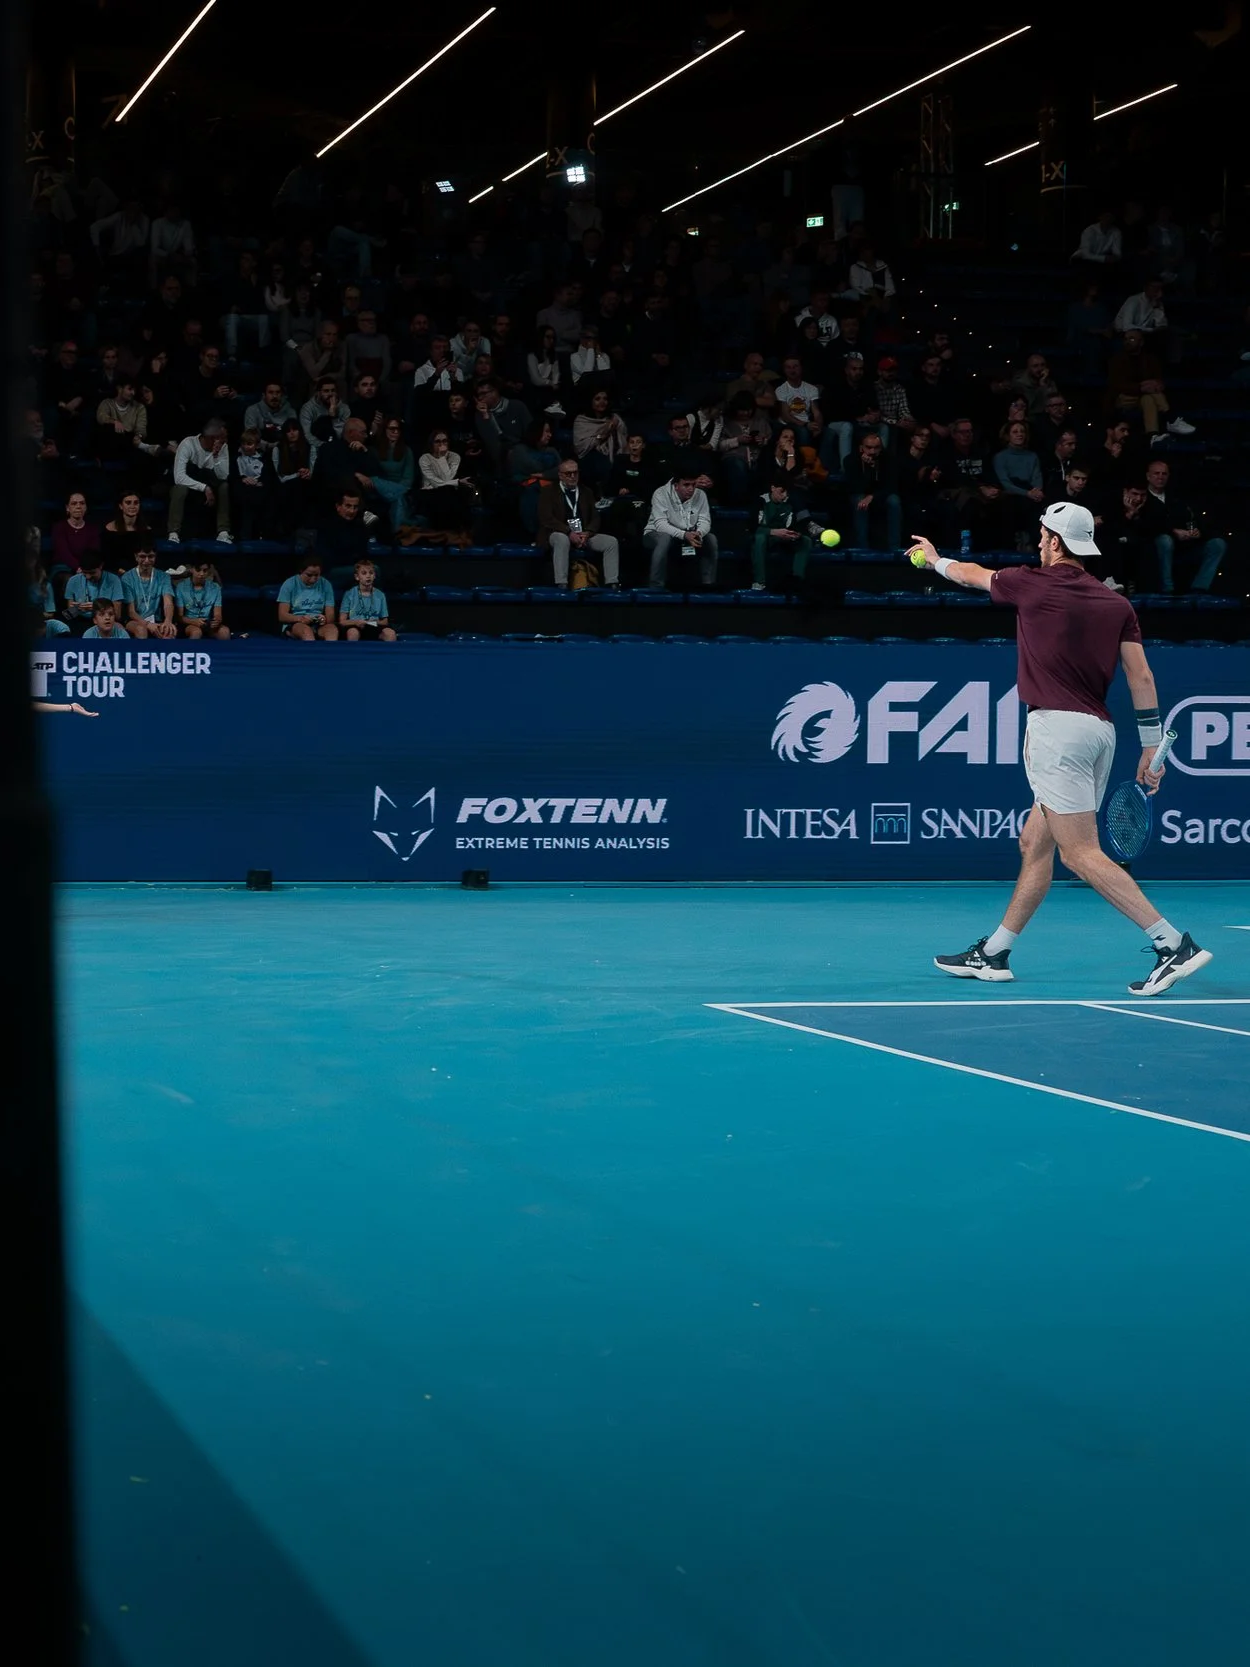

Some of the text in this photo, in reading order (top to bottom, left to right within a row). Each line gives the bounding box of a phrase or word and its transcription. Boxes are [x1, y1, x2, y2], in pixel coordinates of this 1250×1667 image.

[62, 651, 211, 674] CHALLENGER
[62, 675, 125, 698] TOUR
[456, 798, 667, 824] FOXTENN
[744, 808, 860, 839] INTESA
[455, 837, 670, 849] EXTREME TENNIS ANALYSIS
